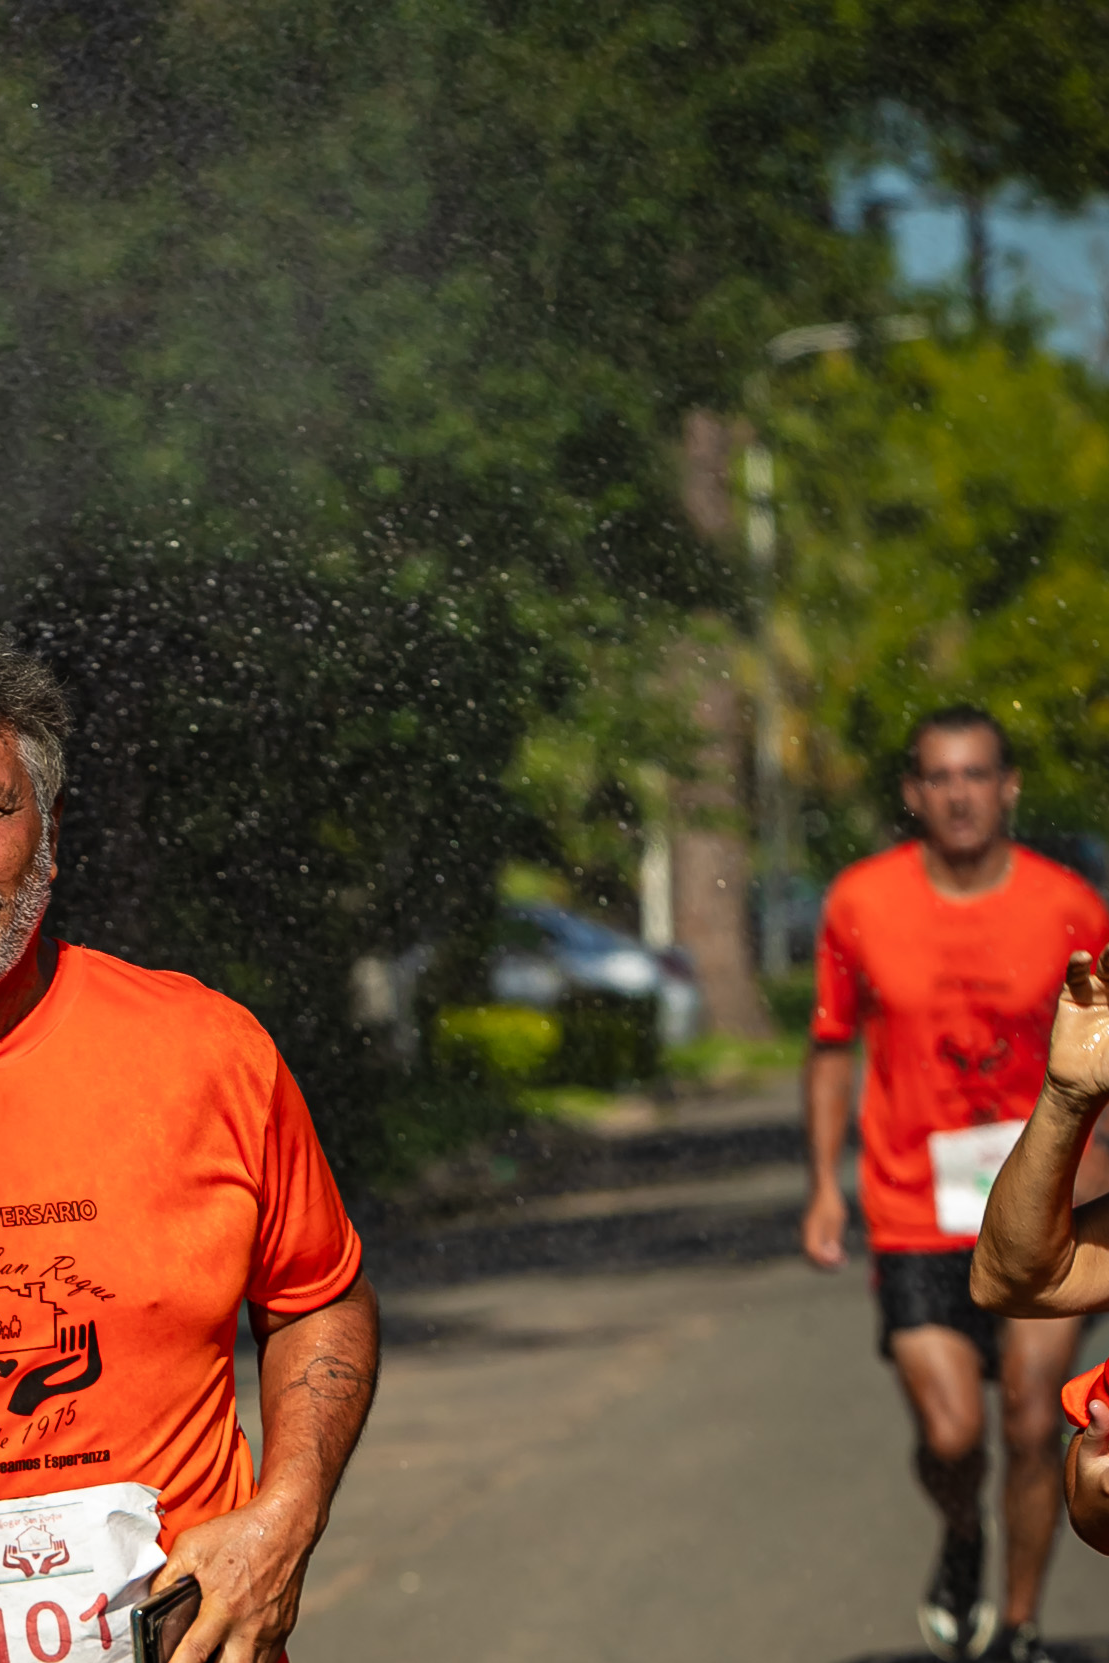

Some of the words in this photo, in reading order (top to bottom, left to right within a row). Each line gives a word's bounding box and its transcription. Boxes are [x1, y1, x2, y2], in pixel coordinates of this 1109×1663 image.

[40, 1256, 116, 1302] Roque
[22, 1400, 78, 1444] 1975
[44, 1449, 110, 1470] Esperanza
